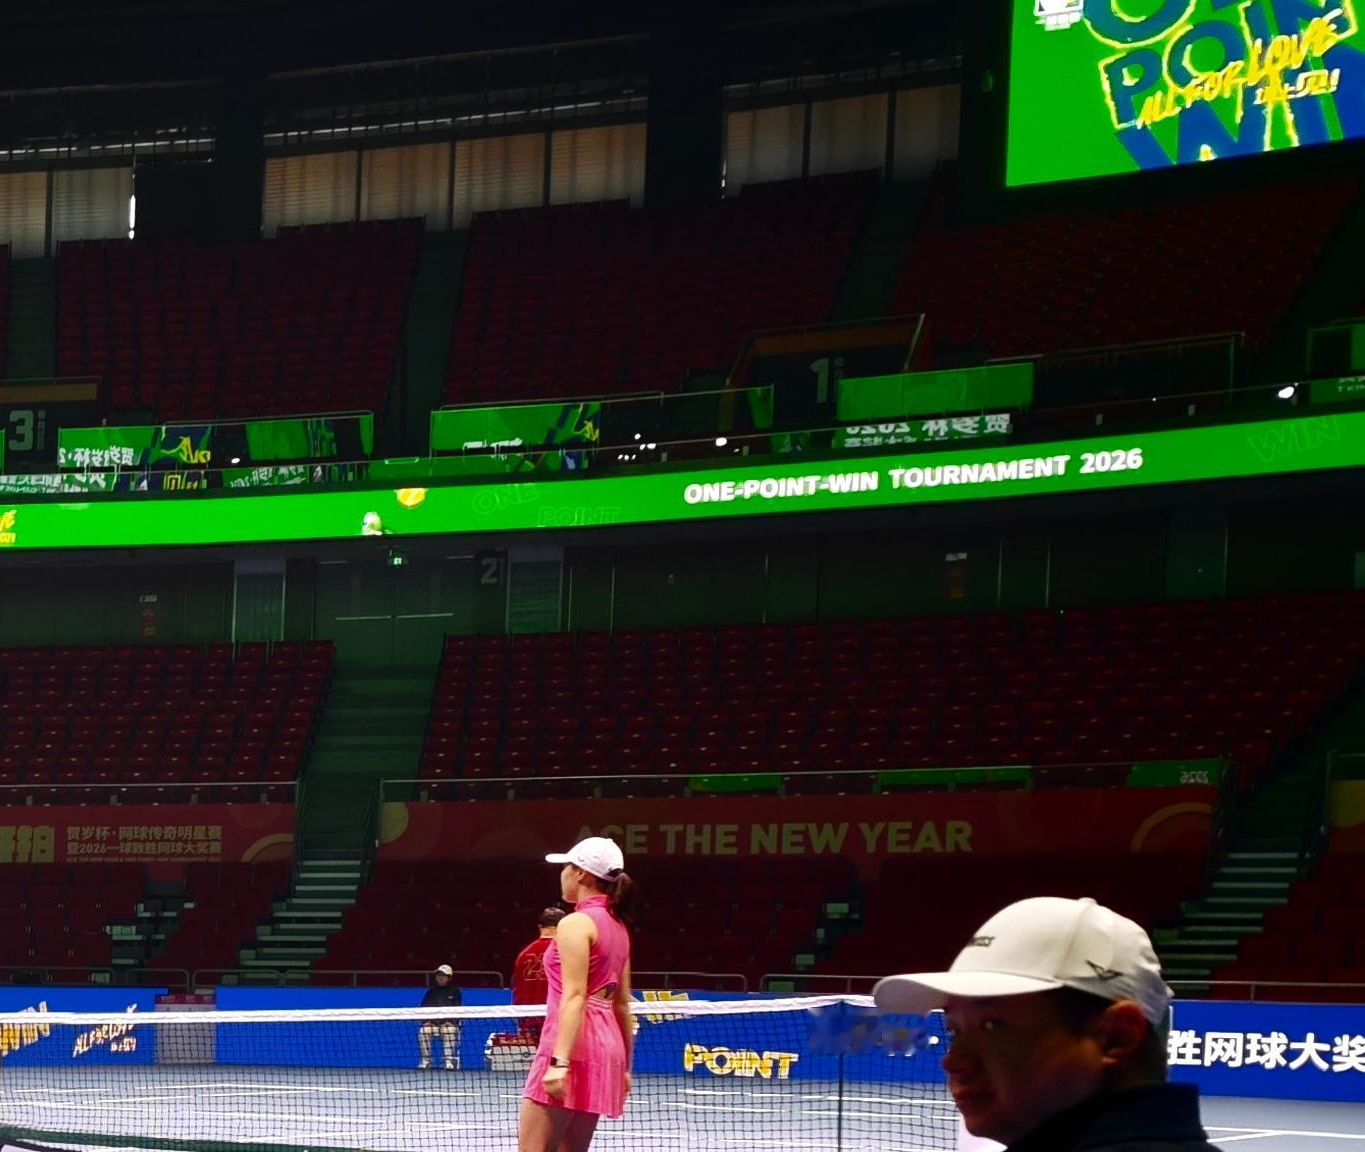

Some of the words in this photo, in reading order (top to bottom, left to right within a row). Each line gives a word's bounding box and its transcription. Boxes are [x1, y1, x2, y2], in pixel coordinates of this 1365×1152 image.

[8, 409, 34, 452] 3
[684, 471, 878, 504] ONE-POINT-WIN
[888, 454, 1070, 489] TOURNAMENT
[1080, 448, 1143, 474] 2026
[659, 823, 739, 855] THE
[749, 822, 851, 855] NEW
[858, 820, 974, 854] YEAR
[684, 1043, 799, 1080] POINT
